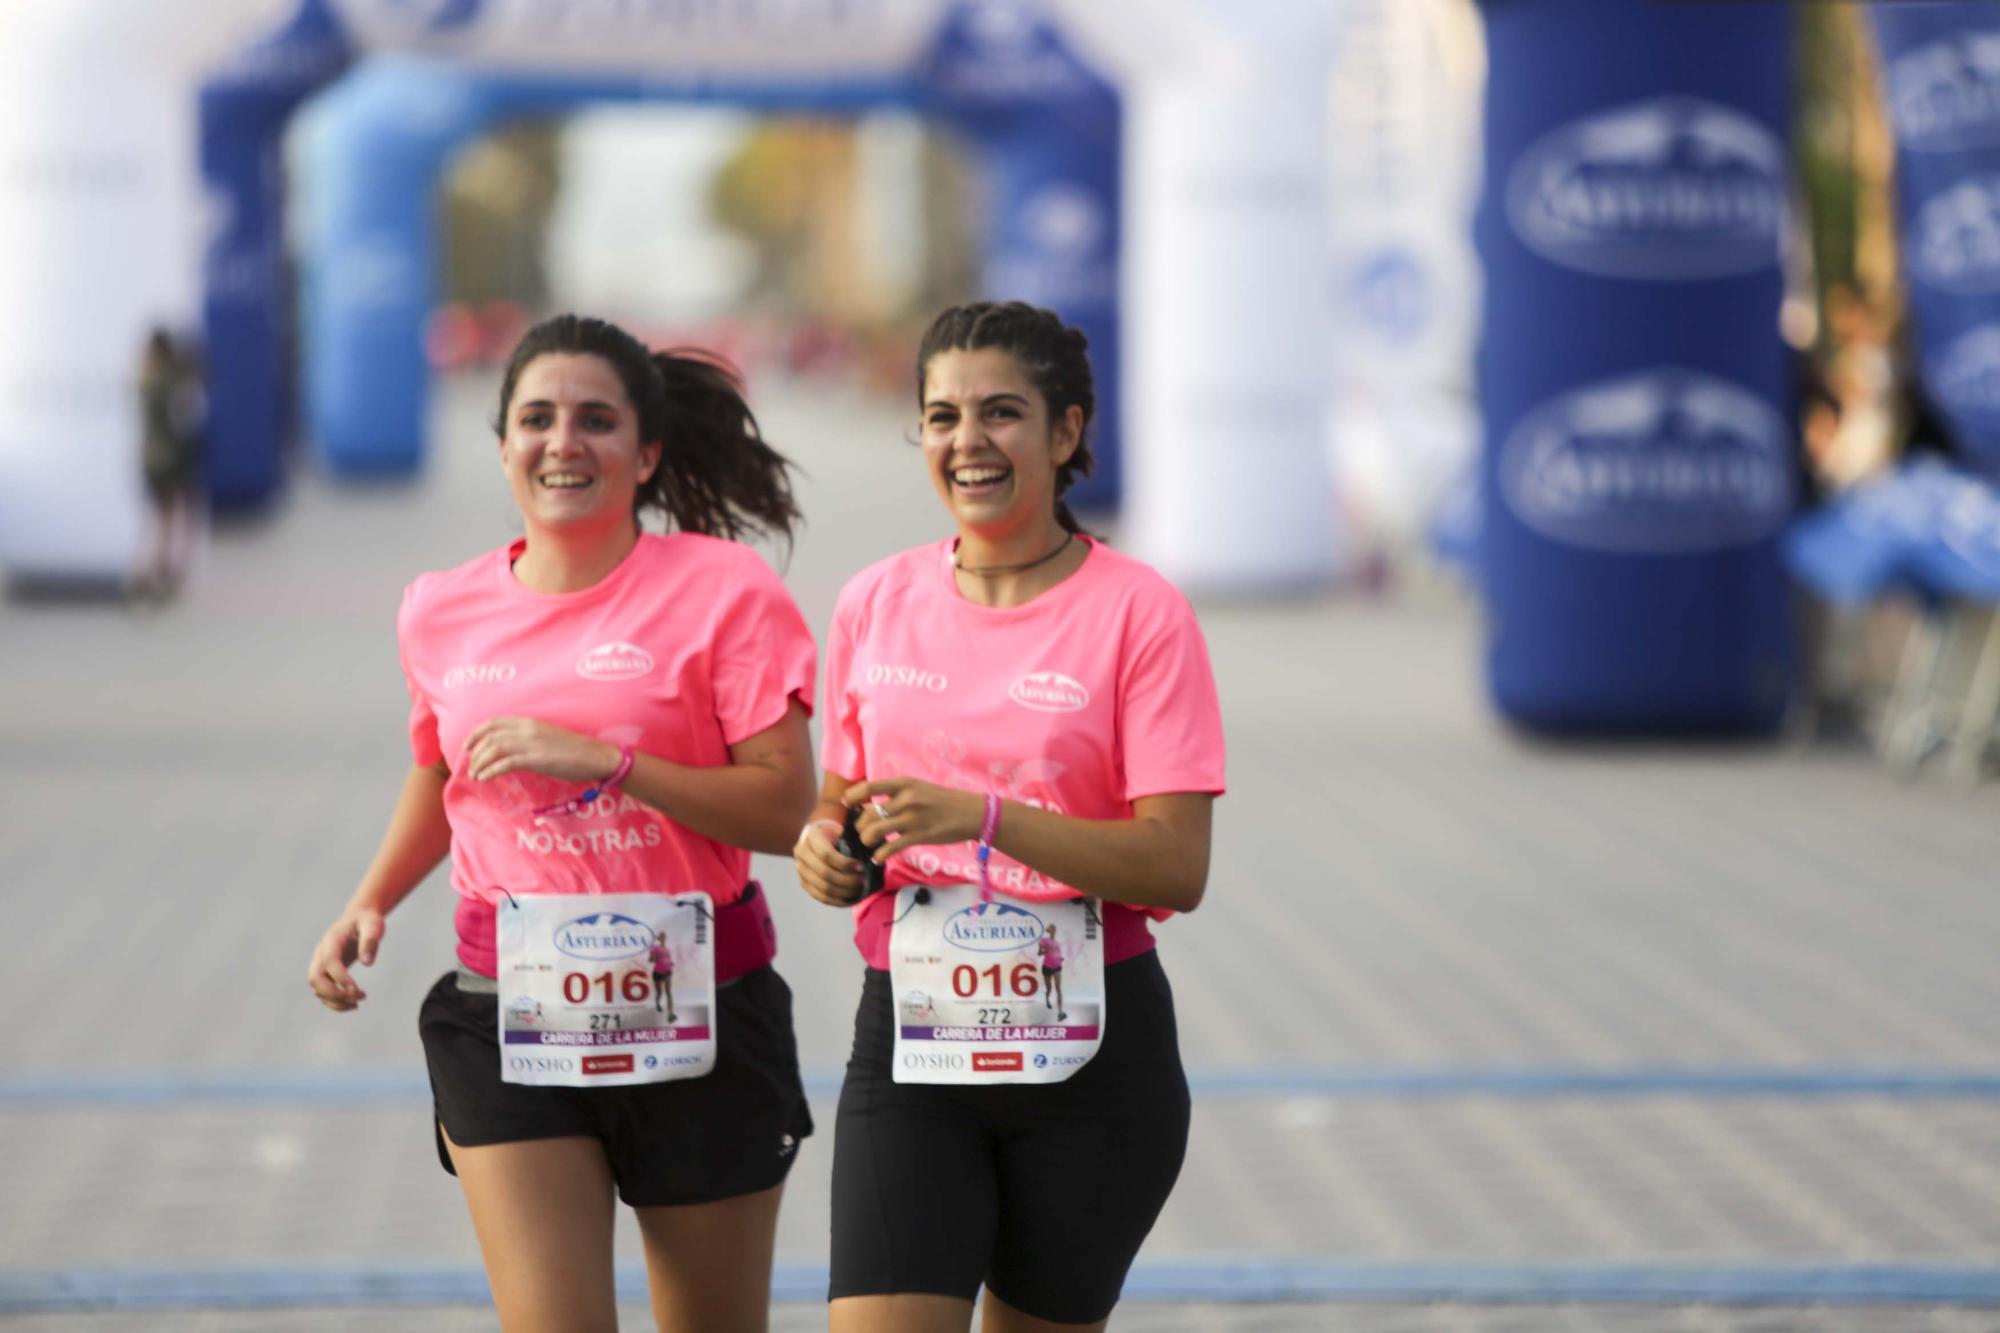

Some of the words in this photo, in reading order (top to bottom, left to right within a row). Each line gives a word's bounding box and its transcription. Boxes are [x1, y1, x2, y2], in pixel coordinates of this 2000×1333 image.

[442, 664, 517, 689] OYSHO
[866, 663, 948, 693] OYSHO
[517, 822, 661, 857] NOSOTRAS
[562, 930, 651, 950] ASTURIANA
[949, 921, 1037, 940] ASTURIANA
[562, 970, 651, 1004] 016
[952, 963, 1040, 998] 016
[589, 1013, 622, 1030] 271
[978, 1008, 1012, 1025] 272
[540, 1031, 594, 1045] CARRERA
[596, 1032, 615, 1045] DE
[615, 1031, 634, 1044] LA
[634, 1029, 678, 1043] MUJER
[932, 1027, 984, 1040] CARRERA
[985, 1027, 1004, 1040] DE
[1004, 1027, 1023, 1040] LA
[1023, 1026, 1068, 1040] MUJER
[510, 1056, 574, 1073] OYSHO
[903, 1054, 964, 1070] OYSHO
